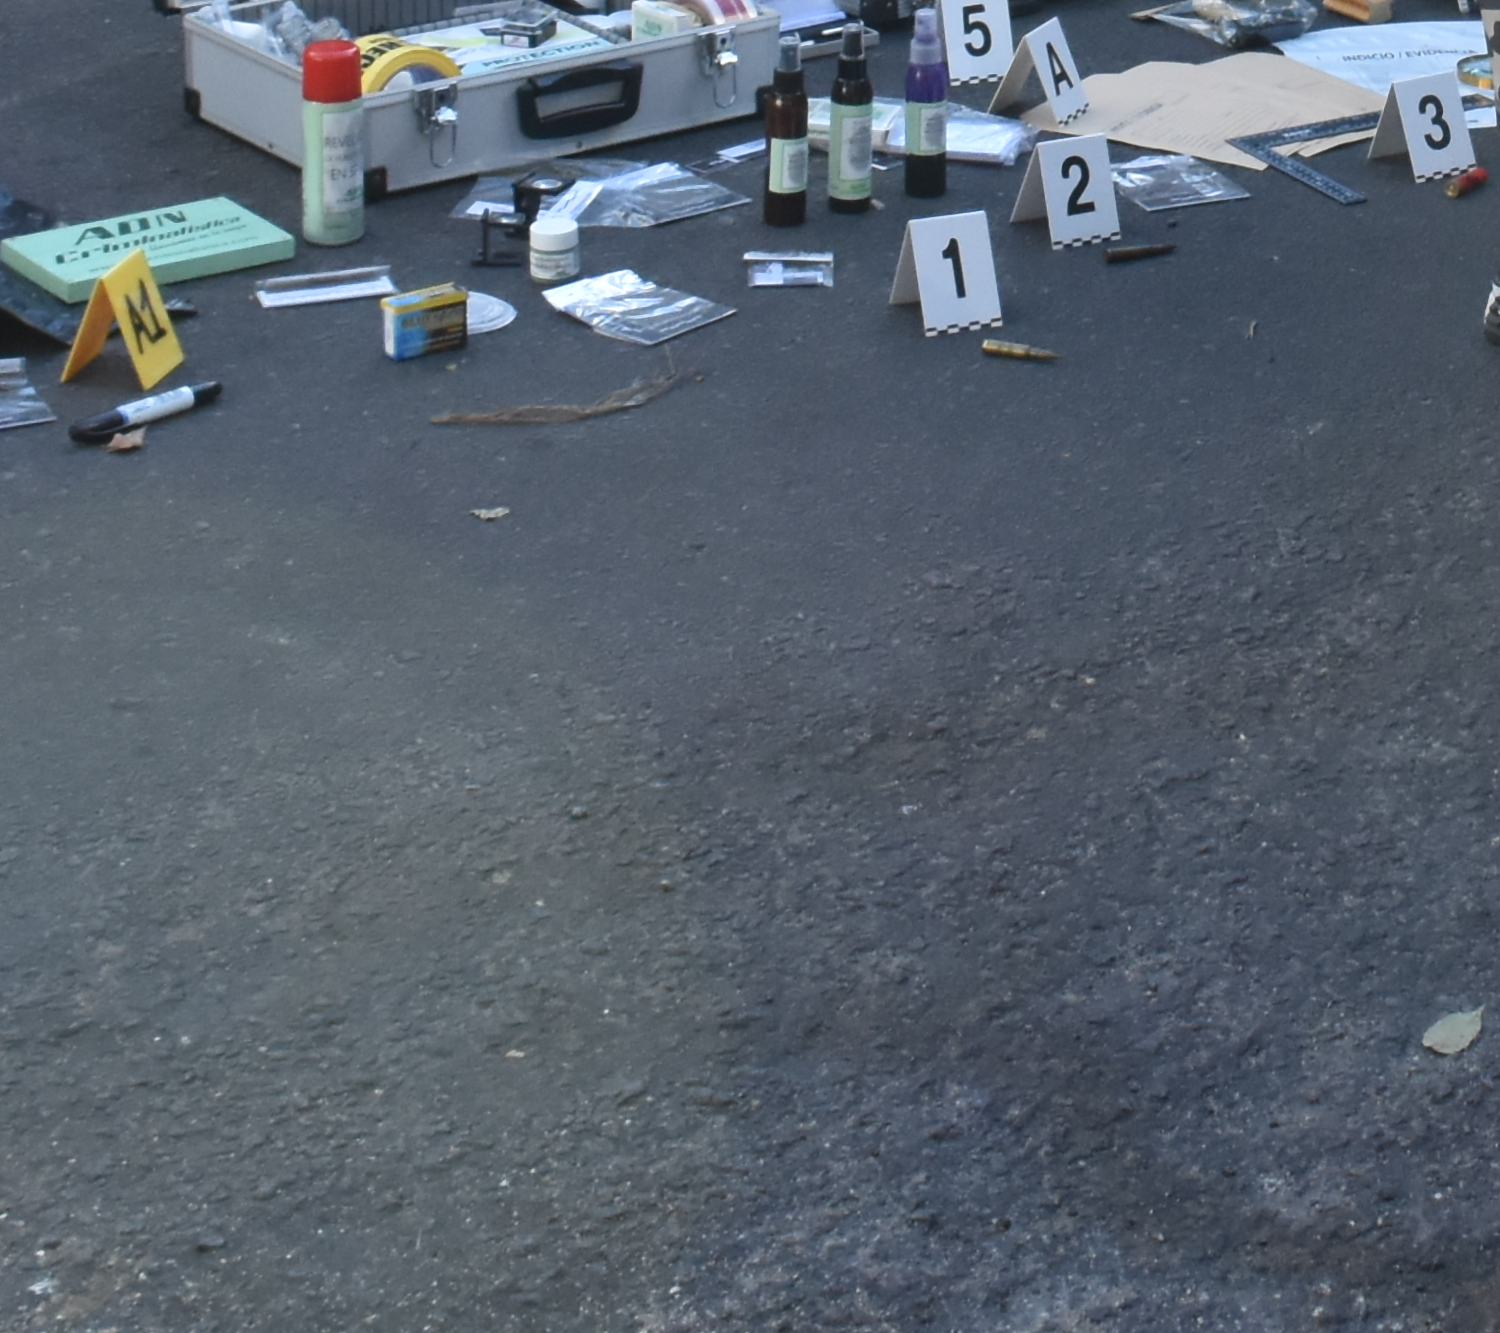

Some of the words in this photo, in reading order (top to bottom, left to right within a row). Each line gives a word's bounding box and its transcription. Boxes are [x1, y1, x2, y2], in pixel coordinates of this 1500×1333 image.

[962, 4, 992, 57] 5
[1342, 51, 1395, 63] INDICIO
[1049, 50, 1078, 97] A
[1418, 94, 1452, 151] 3
[1060, 154, 1096, 217] 2
[75, 210, 187, 245] ADN
[941, 237, 967, 300] 1
[124, 278, 167, 355] A1
